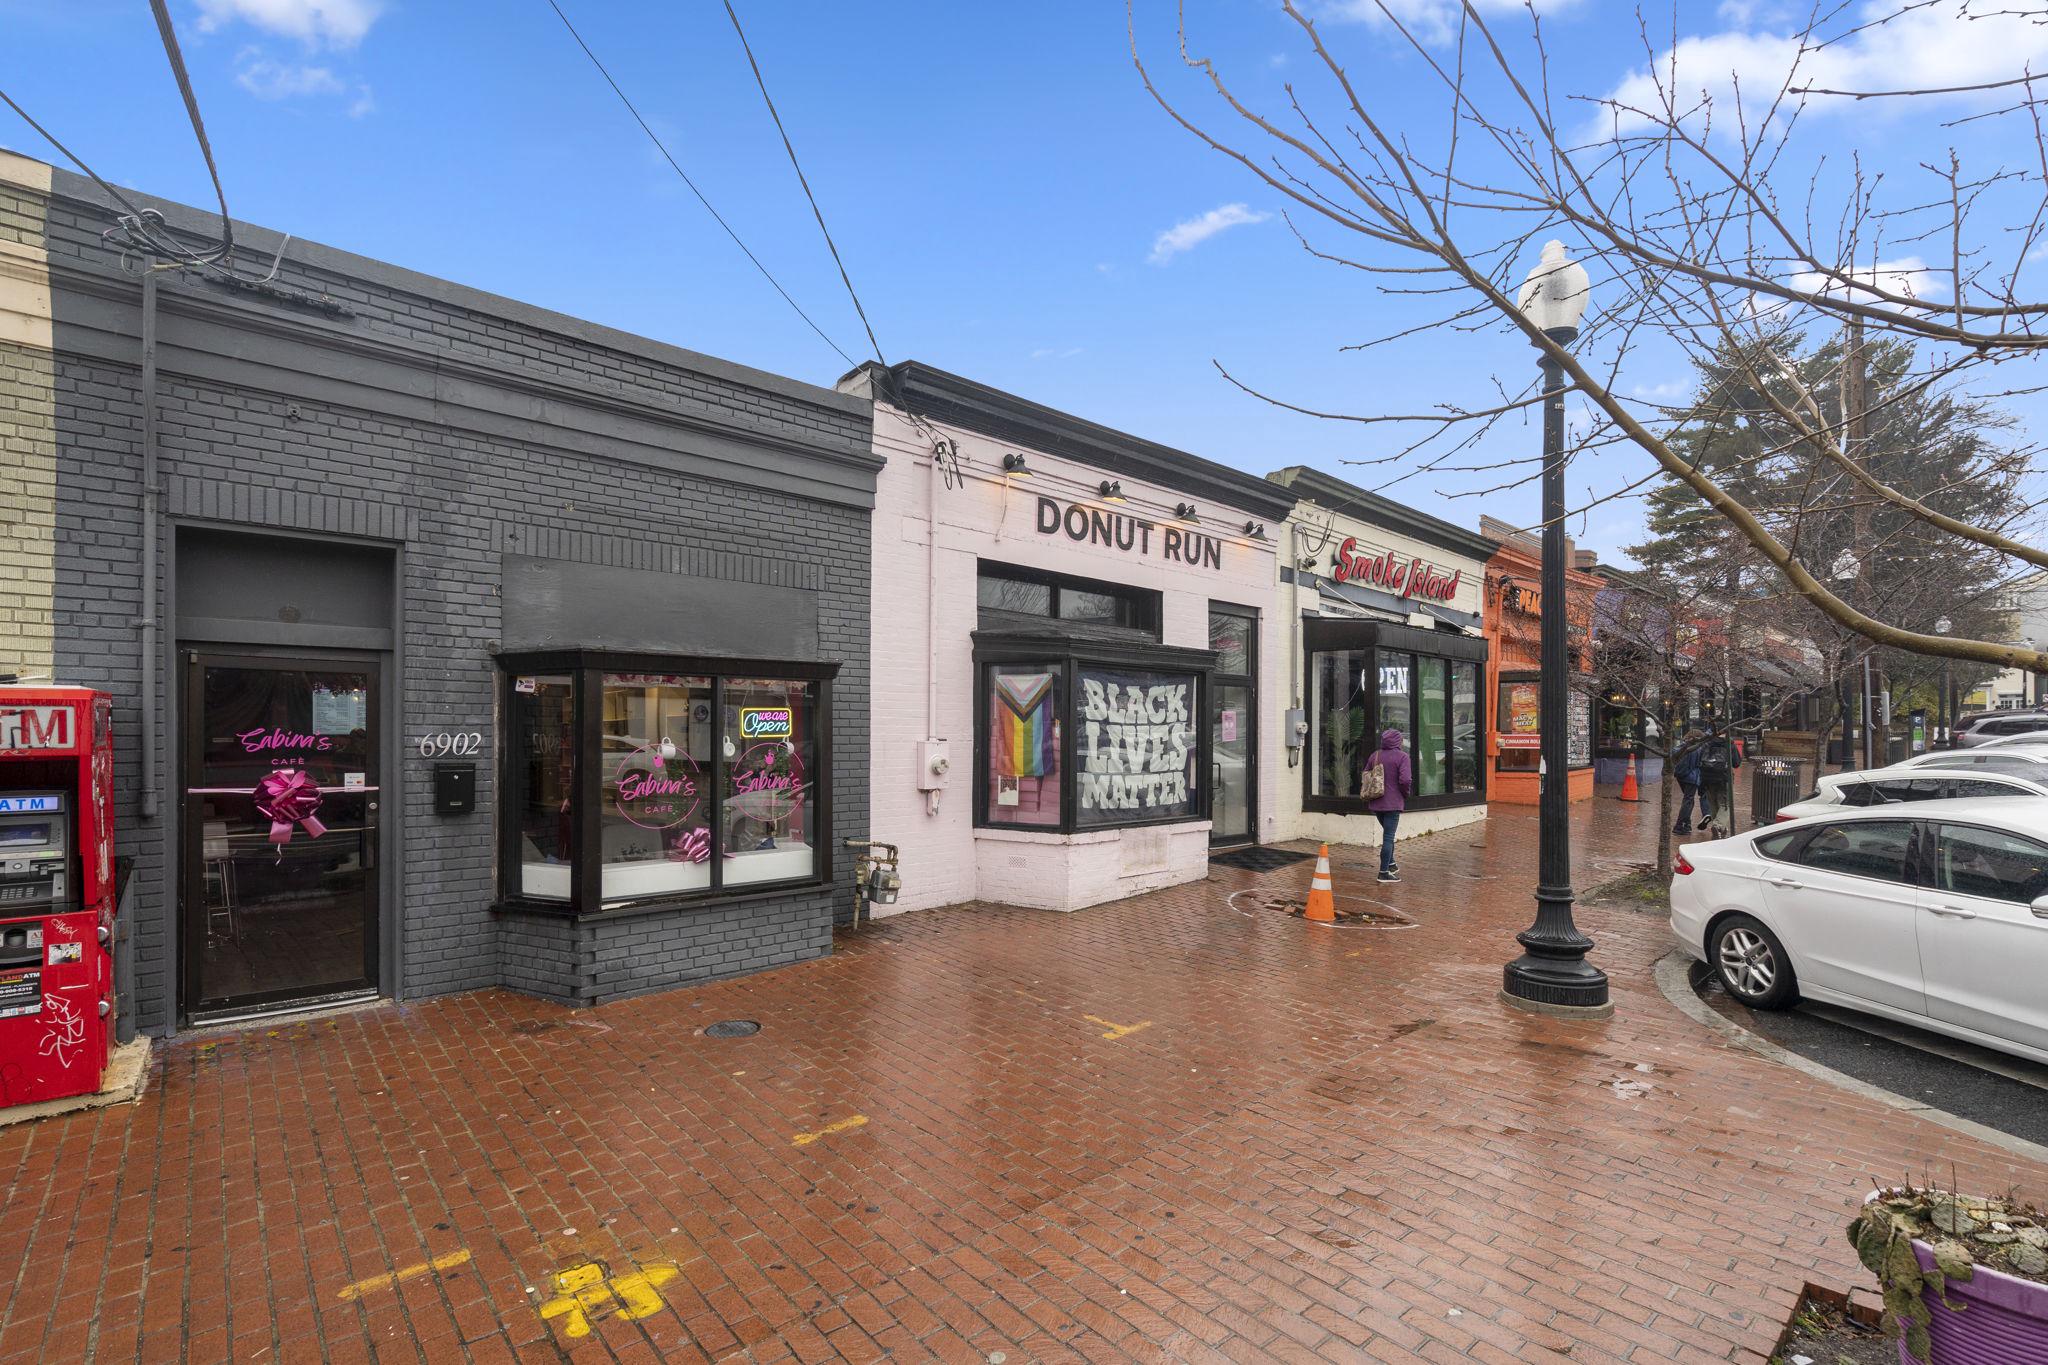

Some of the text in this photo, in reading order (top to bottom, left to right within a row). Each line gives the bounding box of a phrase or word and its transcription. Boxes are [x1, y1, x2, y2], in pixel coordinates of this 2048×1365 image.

[1037, 496, 1221, 570] DONUT RUN
[1332, 537, 1461, 601] Smoke Island
[1083, 678, 1188, 724] BLACK
[744, 712, 789, 737] Open
[236, 727, 333, 752] Sabina's
[420, 732, 482, 757] 6902
[1085, 720, 1188, 773] LIVES
[614, 773, 697, 801] Sabina's
[732, 770, 802, 795] Sabina's
[1082, 771, 1187, 809] MATTER
[0, 798, 45, 811] ATM
